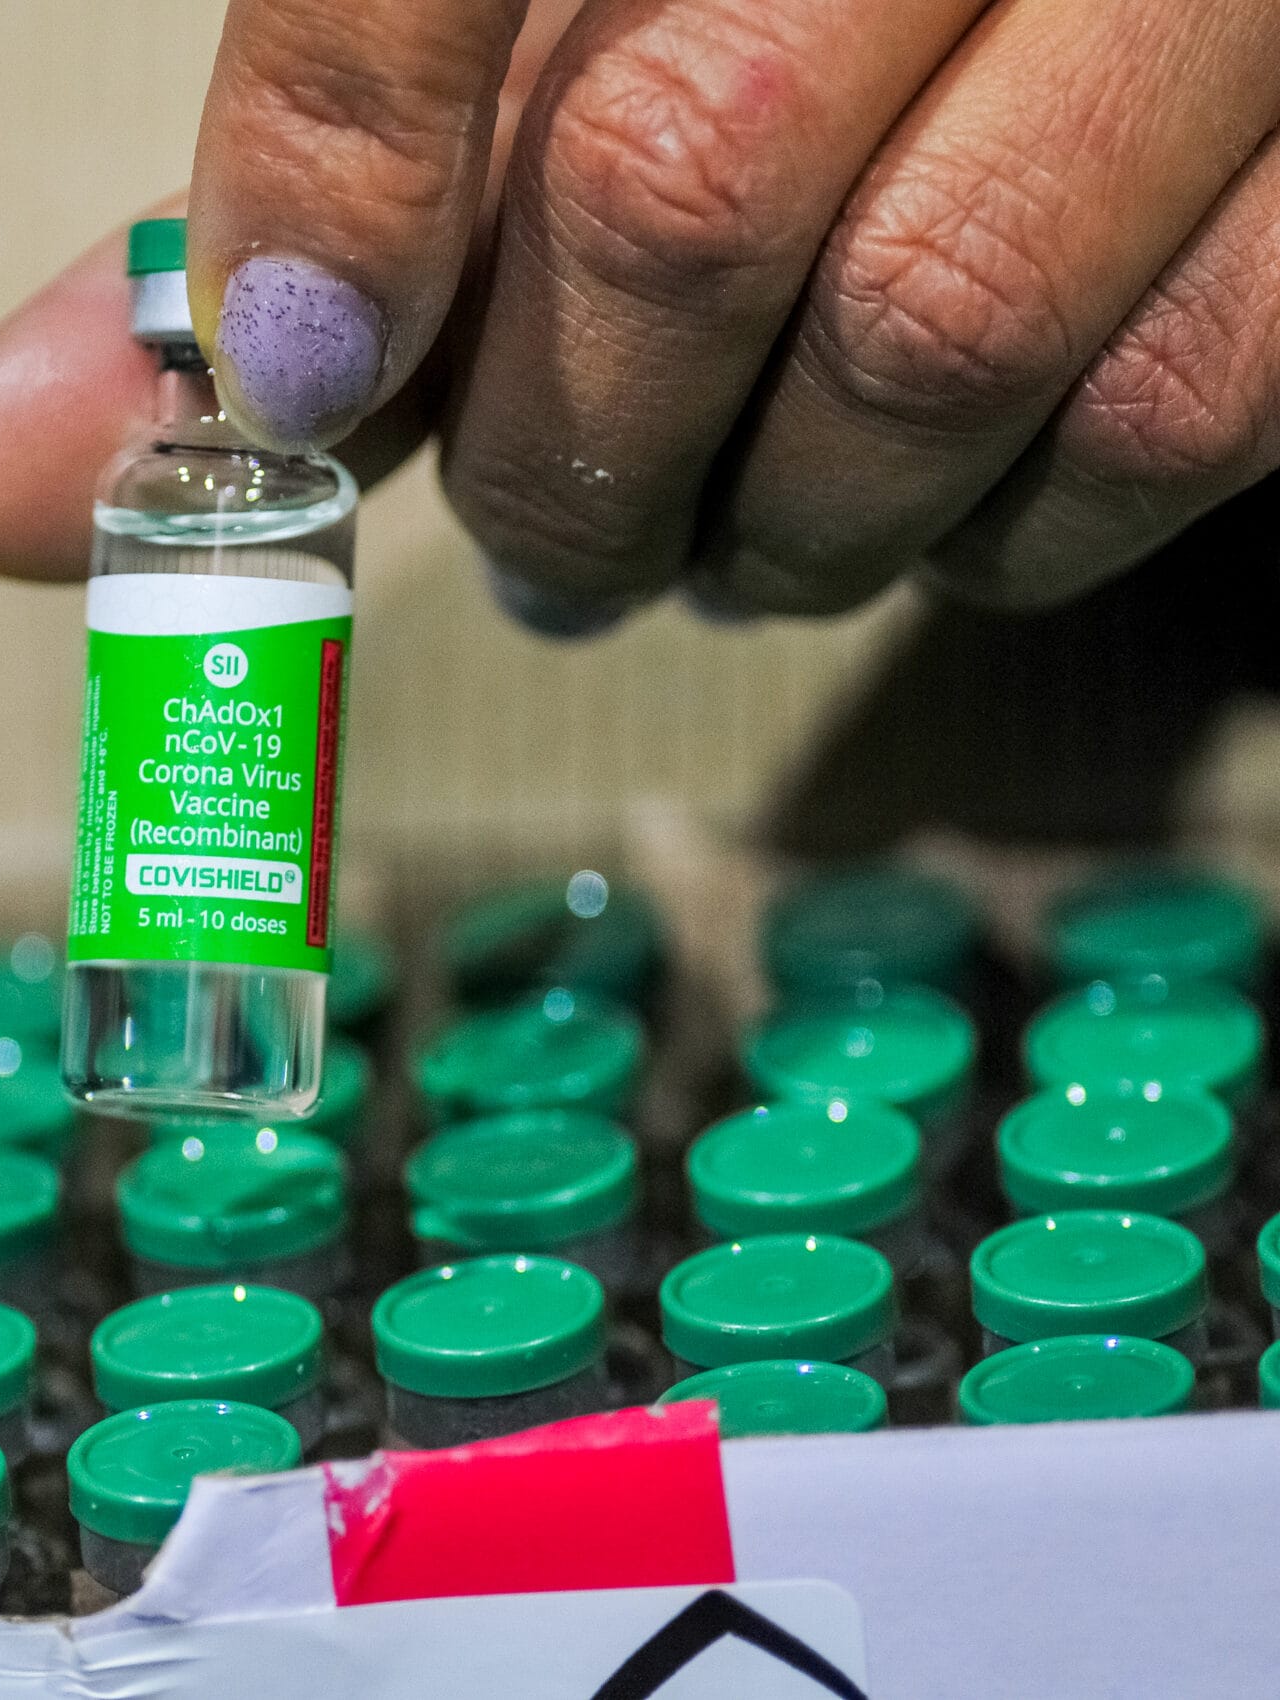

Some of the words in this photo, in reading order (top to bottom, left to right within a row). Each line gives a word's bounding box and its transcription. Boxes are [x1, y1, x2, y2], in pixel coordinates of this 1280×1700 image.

[211, 655, 239, 676] SII
[163, 697, 283, 728] ChAdOx1
[138, 759, 233, 786] Corona
[242, 762, 302, 790] Virus
[169, 790, 270, 819] Vaccine
[105, 790, 118, 851] FROZEN
[130, 818, 302, 854] (Recombinant)
[103, 855, 114, 875] BE
[102, 879, 113, 899] TO
[100, 902, 111, 934] NOT
[138, 908, 150, 927] 5
[230, 911, 287, 934] doses
